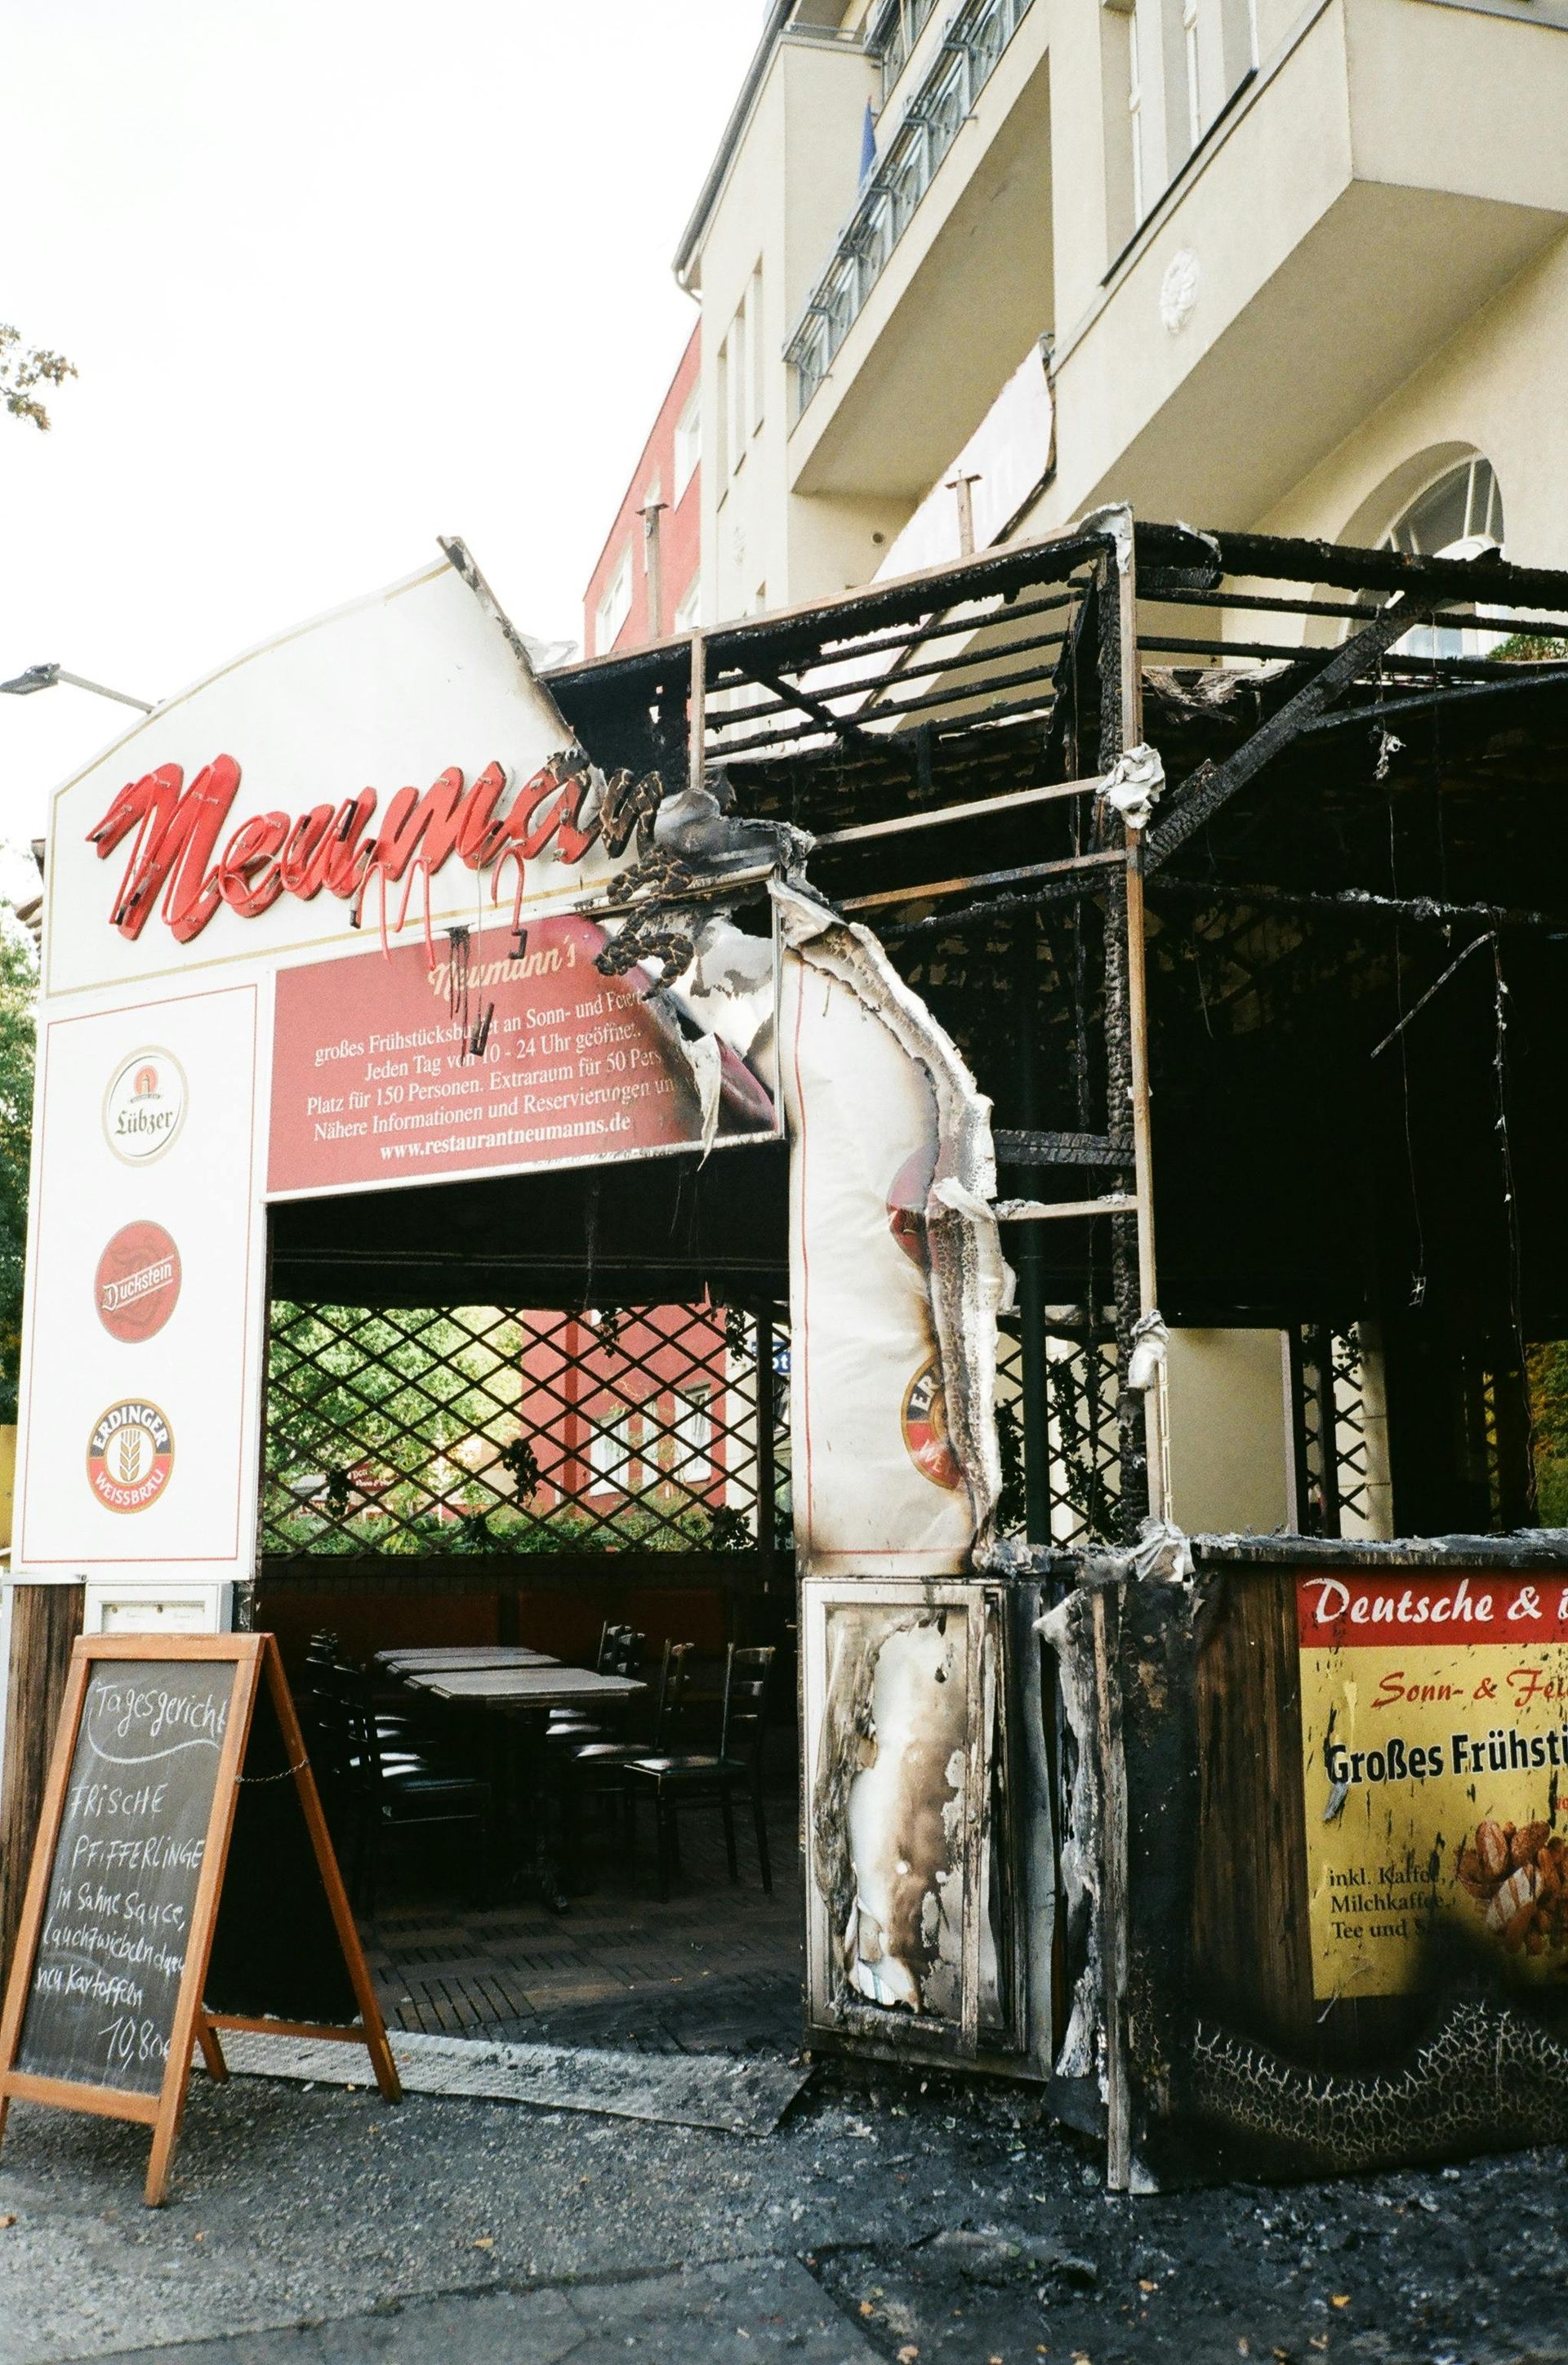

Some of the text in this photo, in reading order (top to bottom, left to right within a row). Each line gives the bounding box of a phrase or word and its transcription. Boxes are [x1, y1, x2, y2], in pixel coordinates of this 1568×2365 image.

[314, 1040, 364, 1067] großes
[504, 1017, 521, 1033] an
[526, 1007, 571, 1029] Sonn-
[576, 994, 603, 1019] und
[365, 1060, 408, 1082] Jeden
[413, 1055, 441, 1076] Tag
[447, 1052, 475, 1069] von
[483, 1043, 500, 1064] 10
[517, 1037, 536, 1059] 24
[541, 1032, 571, 1054] Uhr
[307, 1096, 344, 1116] Platz
[349, 1091, 371, 1111] für
[376, 1085, 403, 1107] 150
[408, 1079, 483, 1102] Personen.
[490, 1065, 572, 1091] Extraraum
[578, 1057, 602, 1078] für
[607, 1050, 626, 1072] 50
[115, 1108, 173, 1135] Lübzer
[314, 1120, 368, 1142] Nähere
[372, 1105, 482, 1134] Informationen
[488, 1097, 518, 1119] und
[523, 1082, 649, 1115] Reservierungen
[381, 1111, 631, 1161] www.restaurantneumanns.de
[102, 1263, 172, 1312] Duckstein
[92, 1405, 170, 1452] ERDINGER
[95, 1468, 164, 1508] WEISSBRÄU
[1303, 1577, 1494, 1623] Deutsche
[1508, 1586, 1543, 1621] &
[96, 1685, 228, 1738] Tagesgericht
[1370, 1671, 1463, 1708] Sonn-
[1472, 1677, 1496, 1700] &
[1328, 1737, 1445, 1784] Großes
[1330, 1867, 1371, 1887] inkl.
[56, 1880, 185, 1931] in Sahne Sauce,
[1331, 1922, 1364, 1940] Tee
[1370, 1918, 1408, 1938] und
[65, 1963, 144, 2008] Kartoffeln
